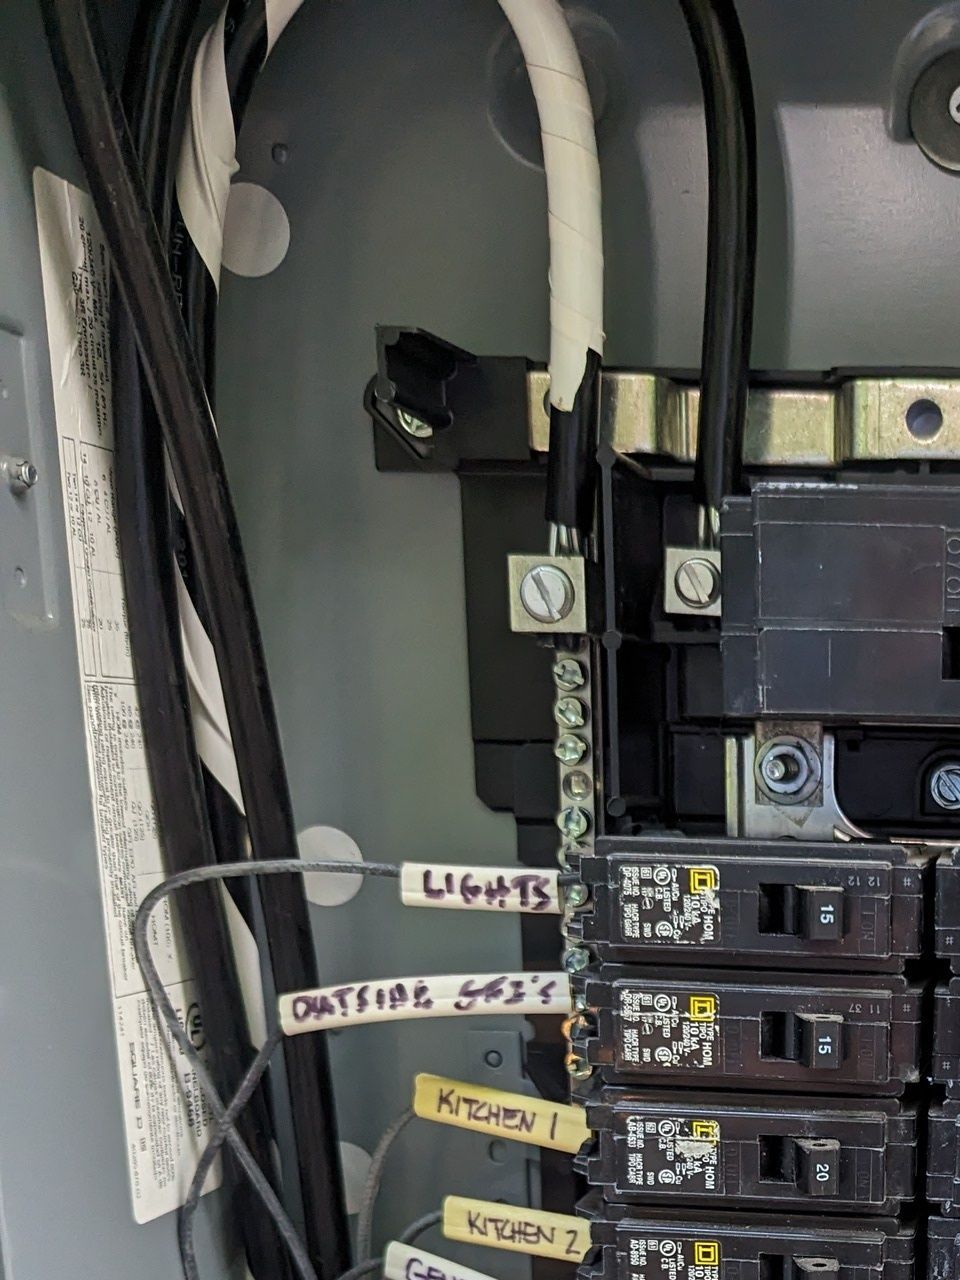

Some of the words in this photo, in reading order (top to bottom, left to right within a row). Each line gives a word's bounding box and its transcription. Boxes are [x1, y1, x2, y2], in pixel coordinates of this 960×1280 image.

[424, 868, 550, 911] LIGHTS
[663, 887, 671, 912] LISTED
[820, 905, 834, 924] 15
[702, 1042, 712, 1065] HOM
[819, 1036, 832, 1054] 15
[436, 1088, 536, 1133] KITCHEN
[705, 1166, 715, 1189] HOM
[816, 1163, 829, 1181] 20
[467, 1210, 555, 1244] KITCHEN
[565, 1229, 580, 1255] 2
